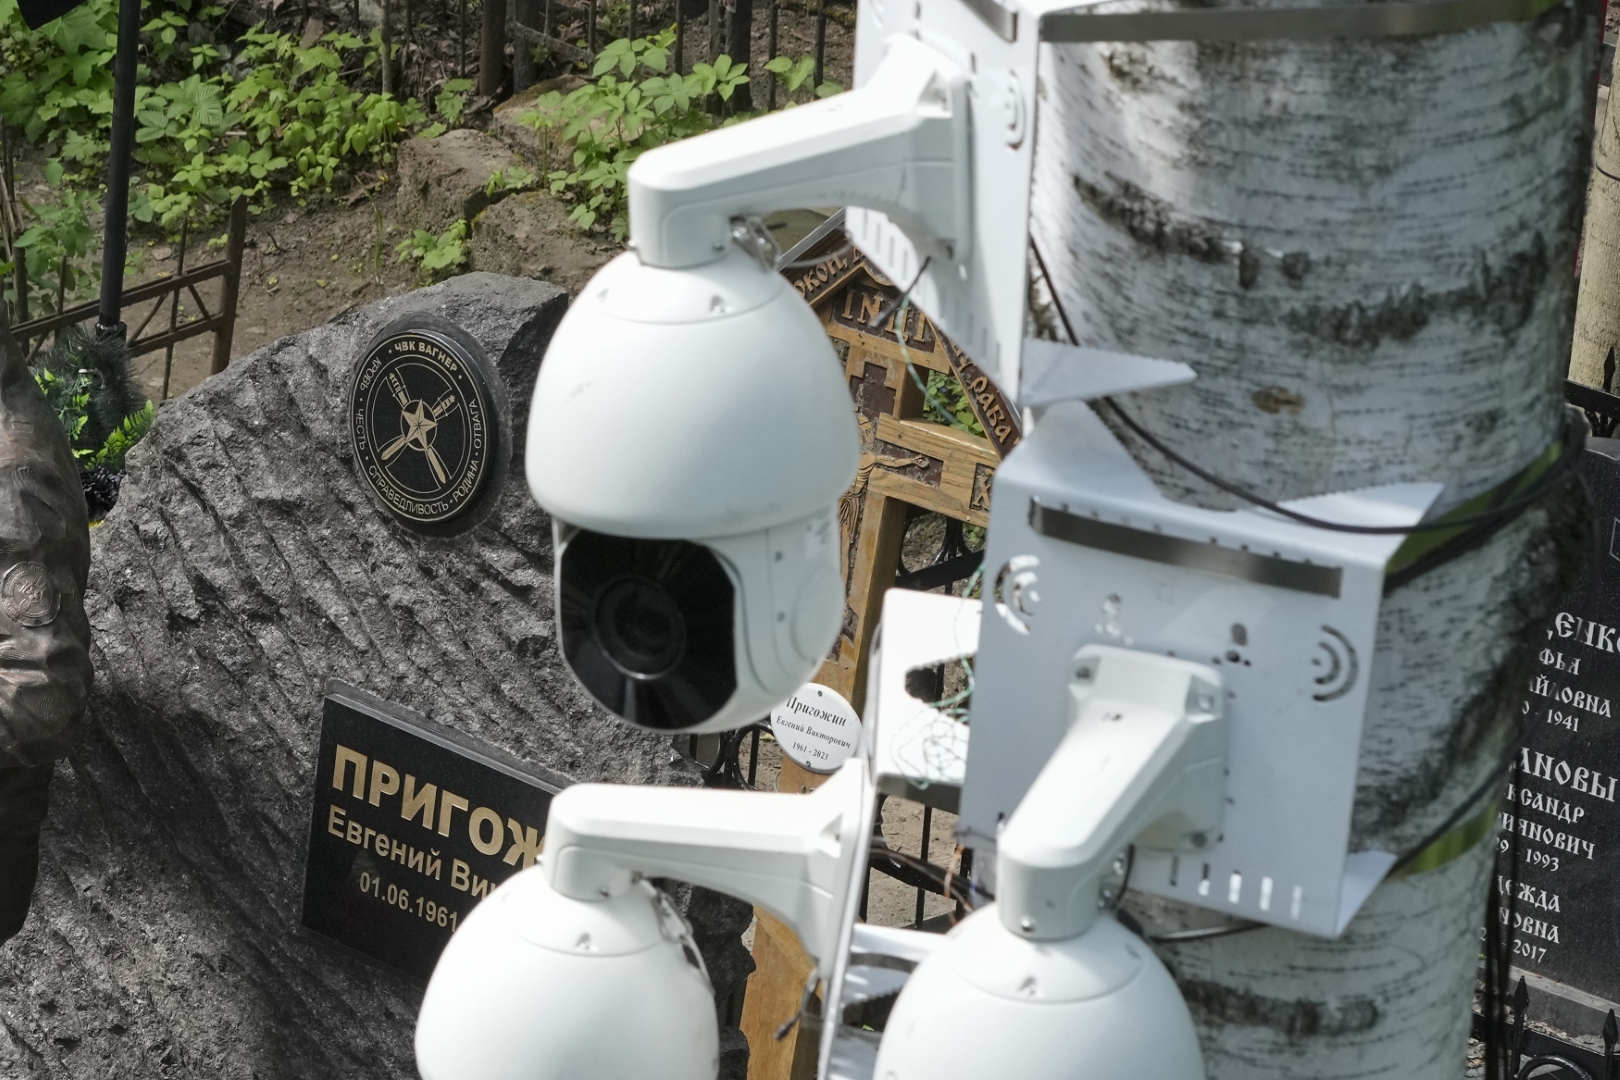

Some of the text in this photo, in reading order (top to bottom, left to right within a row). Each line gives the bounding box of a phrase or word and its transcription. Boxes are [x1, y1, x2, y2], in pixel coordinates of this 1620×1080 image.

[359, 356, 382, 391] КРОВЬ
[394, 341, 458, 373] ЧВК ВАГНЕР
[355, 408, 367, 451] ЧЕСТЬ
[469, 398, 482, 449] ОТВАГА
[368, 465, 449, 515] СПРАВЕДЛИВОСТЬ
[452, 459, 479, 503] РОДИНА
[1539, 647, 1581, 676] ФЬЯ
[786, 696, 847, 727] Пригожин
[1547, 708, 1579, 733] 1941
[776, 716, 851, 749] Евгений Викторович
[792, 742, 807, 753] 1961
[813, 748, 829, 760] 2023
[1509, 746, 1618, 803] АНОВЫ
[332, 743, 546, 870] ПРИГОЖ
[1506, 783, 1585, 824] КСАНДР
[327, 803, 441, 881] Евгений
[1498, 812, 1596, 860] ИЯНОВИЧ
[1525, 848, 1559, 872] 1993
[359, 871, 458, 932] 01.06.1961
[1513, 939, 1547, 963] 2017
